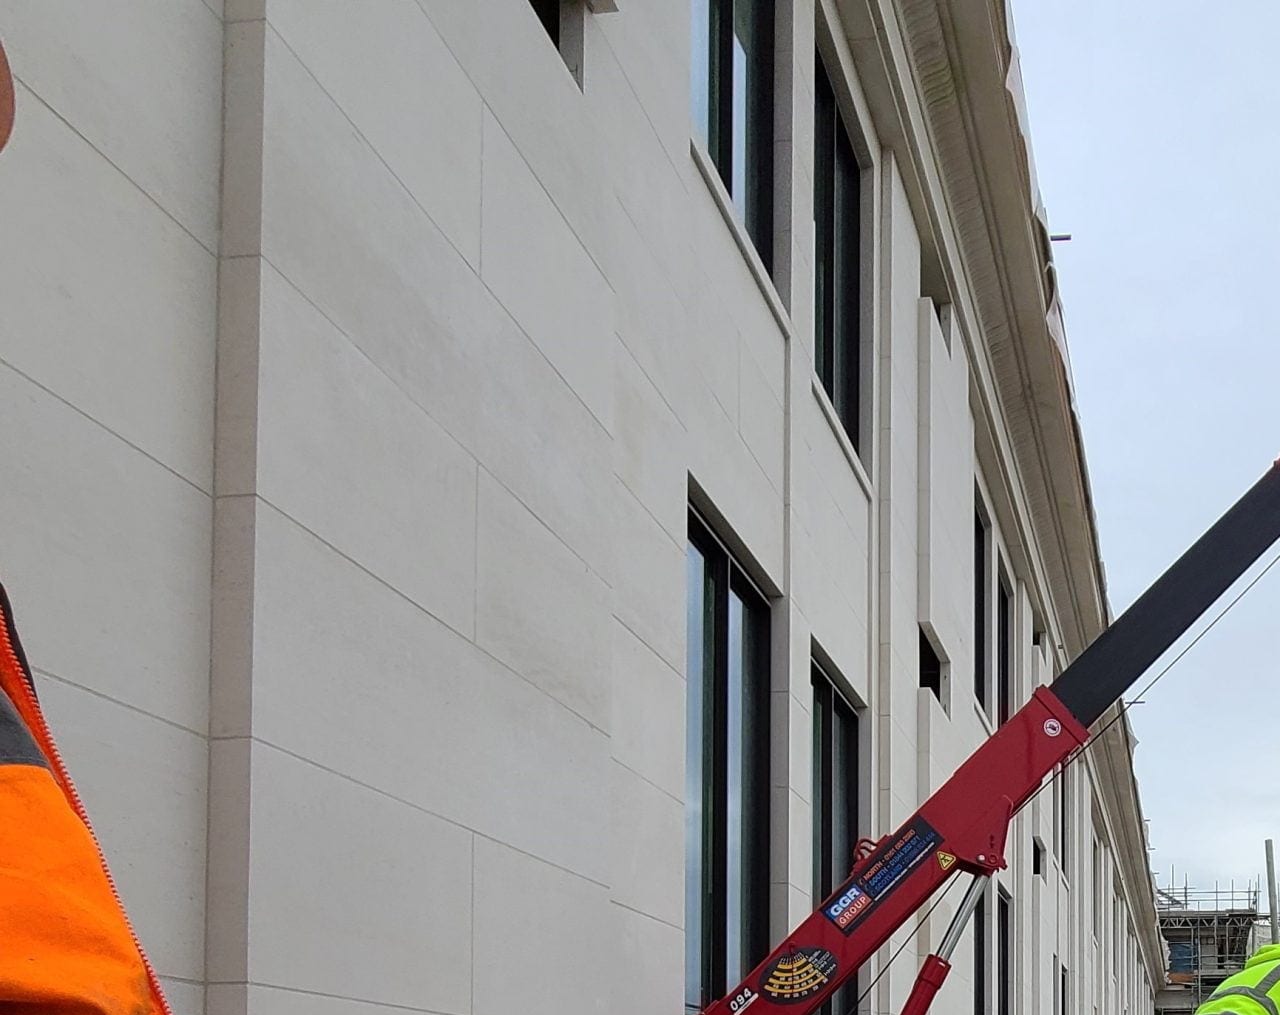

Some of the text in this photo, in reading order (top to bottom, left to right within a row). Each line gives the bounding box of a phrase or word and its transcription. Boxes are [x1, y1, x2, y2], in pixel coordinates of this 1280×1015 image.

[863, 861, 883, 881] NORTH
[869, 868, 888, 887] SOUTH
[830, 888, 861, 917] GGR
[839, 896, 868, 925] GROUP
[730, 988, 752, 1011] 094
